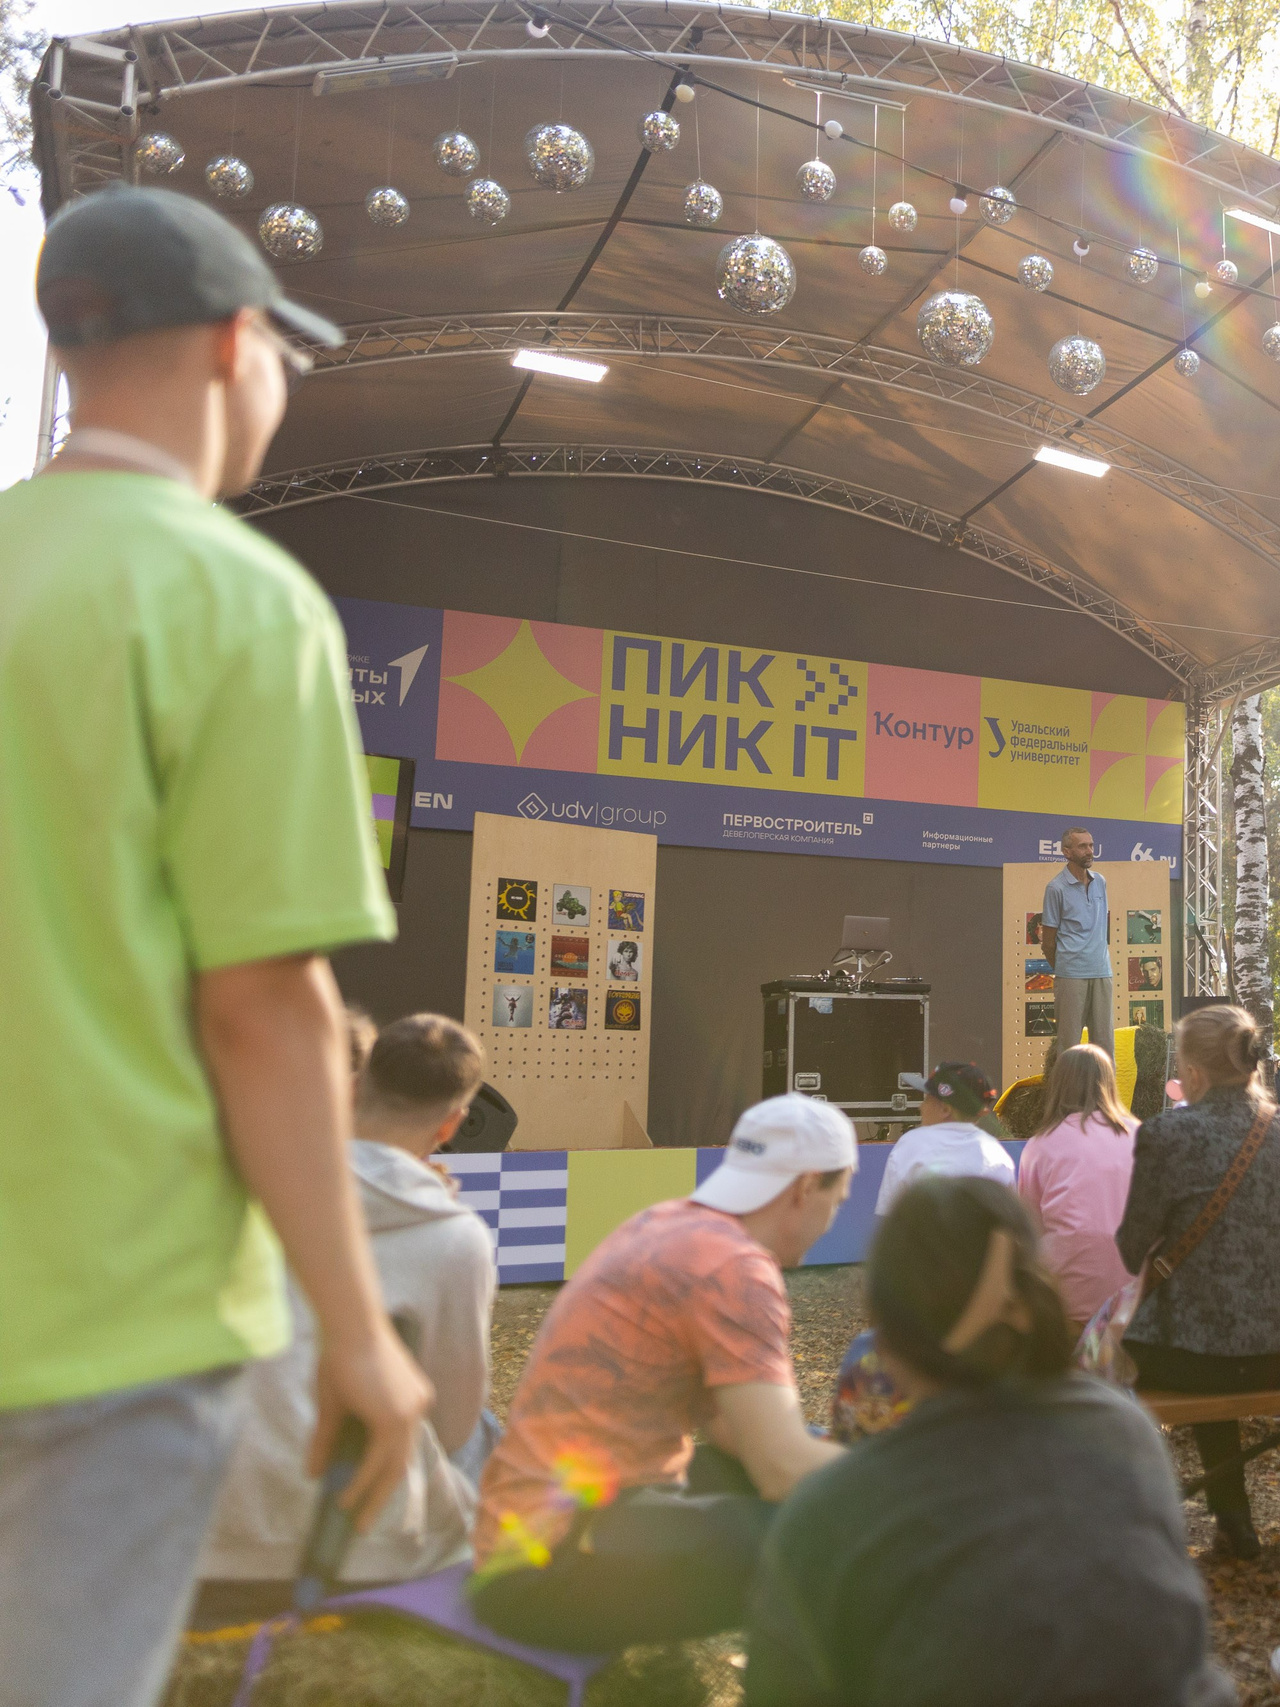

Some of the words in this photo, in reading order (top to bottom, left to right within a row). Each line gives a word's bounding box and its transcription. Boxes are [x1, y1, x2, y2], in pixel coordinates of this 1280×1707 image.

[611, 635, 776, 708] ПИК
[874, 711, 974, 749] Контур
[1011, 720, 1070, 737] Уральский
[608, 704, 774, 775] НИК
[793, 724, 857, 780] IT
[1010, 735, 1088, 753] федеральный
[1010, 750, 1080, 766] университет
[414, 791, 453, 809] EN
[723, 813, 862, 836] ПЕРВОСТРОИТЕЛЬ
[722, 829, 790, 841] ДЕВЕЛОПЕРСКАЯ
[790, 835, 834, 845] КОМПАНИЯ
[922, 830, 994, 843] Информационные
[922, 841, 960, 851] партнеры
